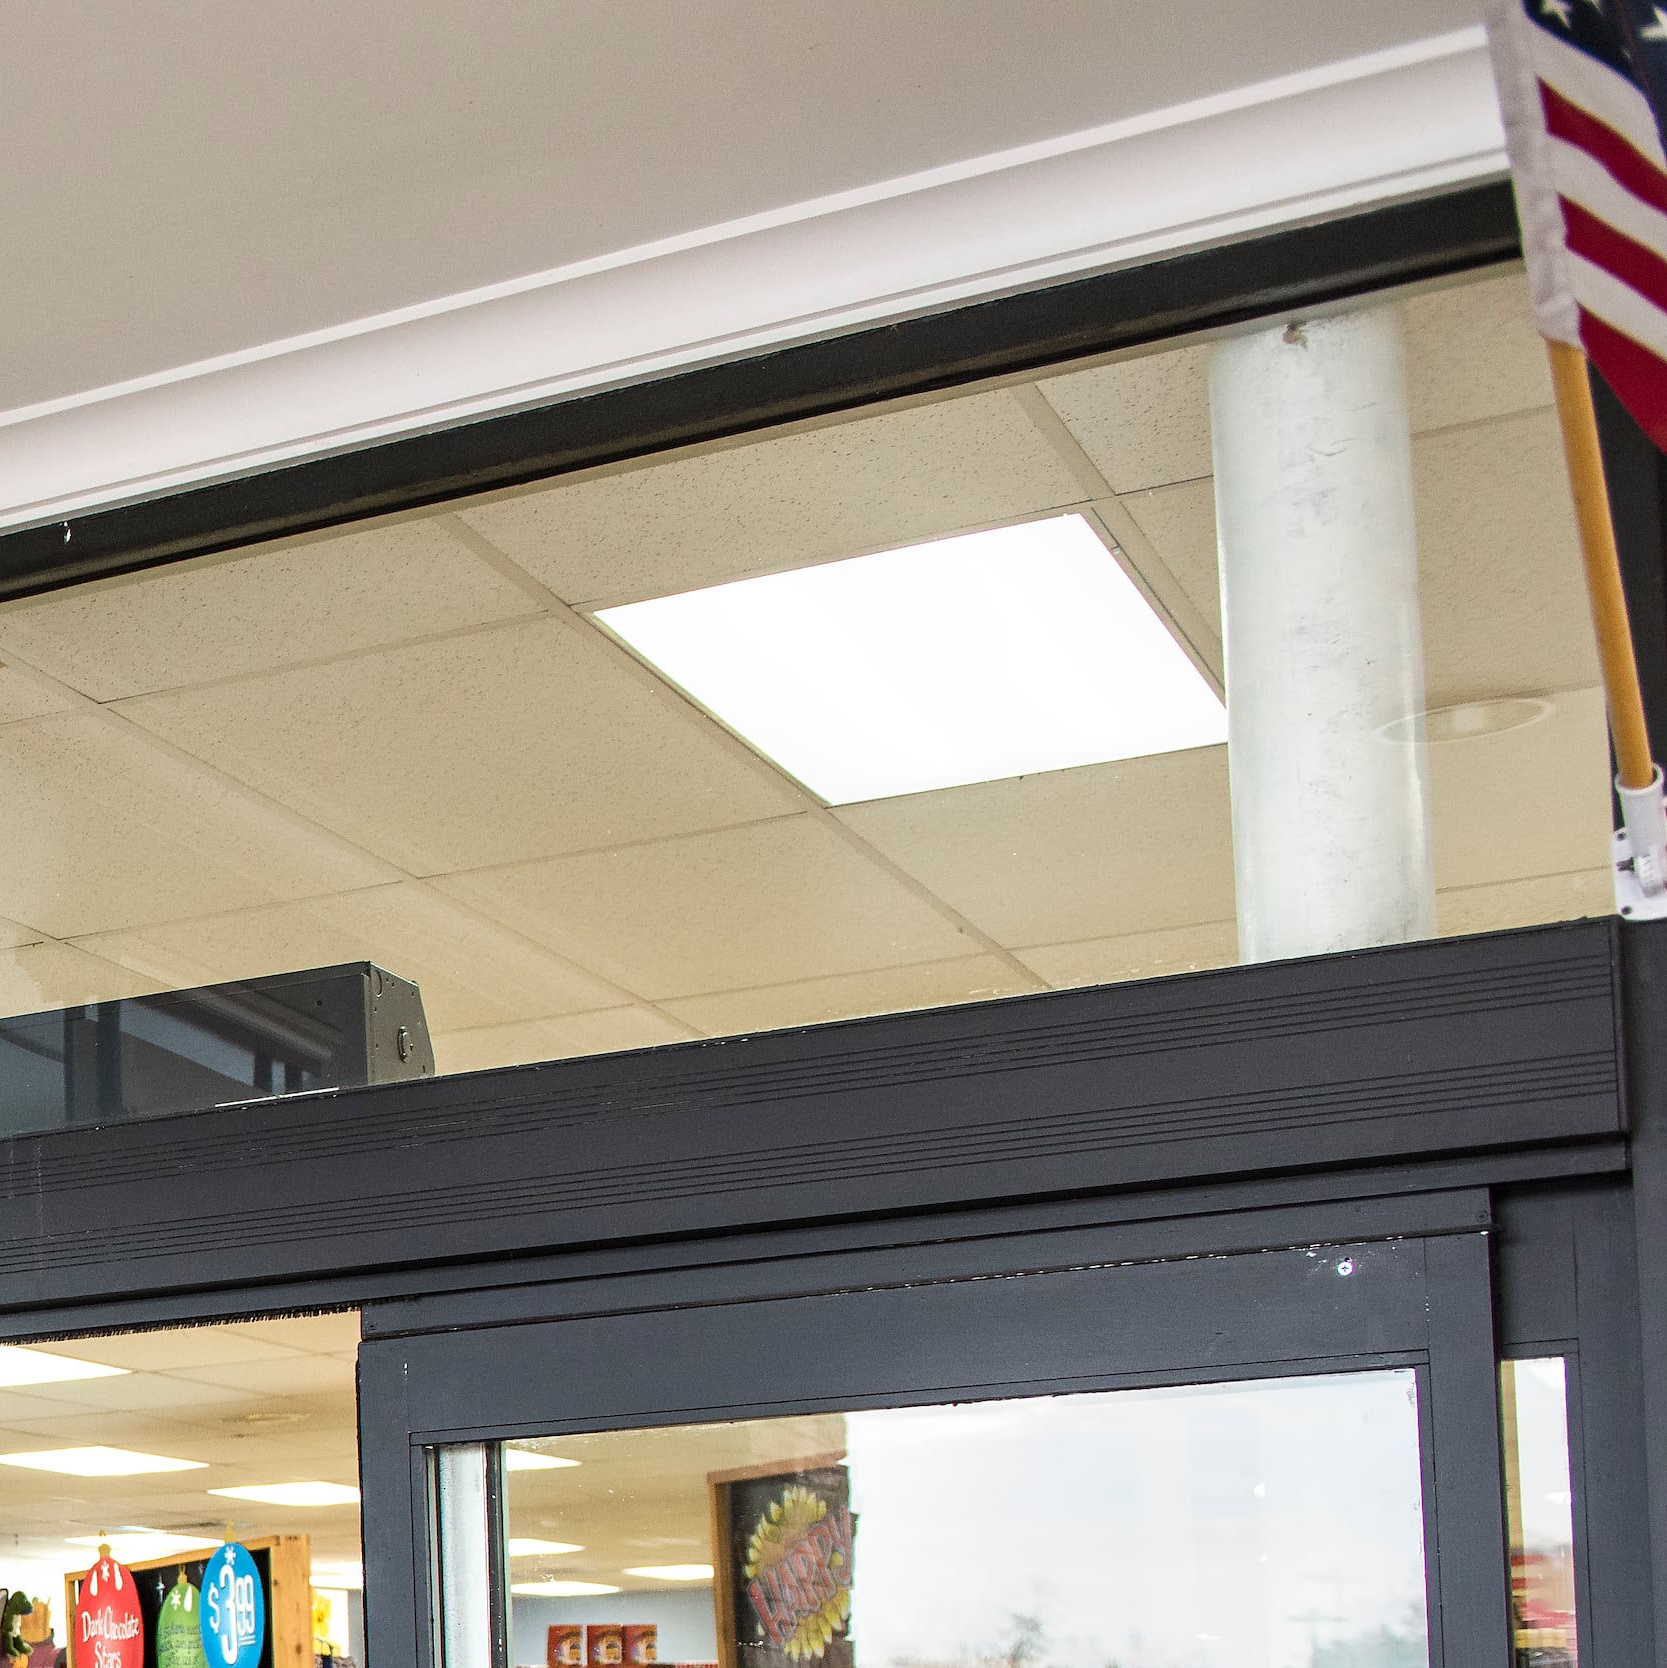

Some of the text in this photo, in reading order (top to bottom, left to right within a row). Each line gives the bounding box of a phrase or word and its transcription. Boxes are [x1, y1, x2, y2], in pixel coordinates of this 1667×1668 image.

[747, 1507, 853, 1647] HAPPY
[81, 1605, 140, 1642] Dark Chocolate
